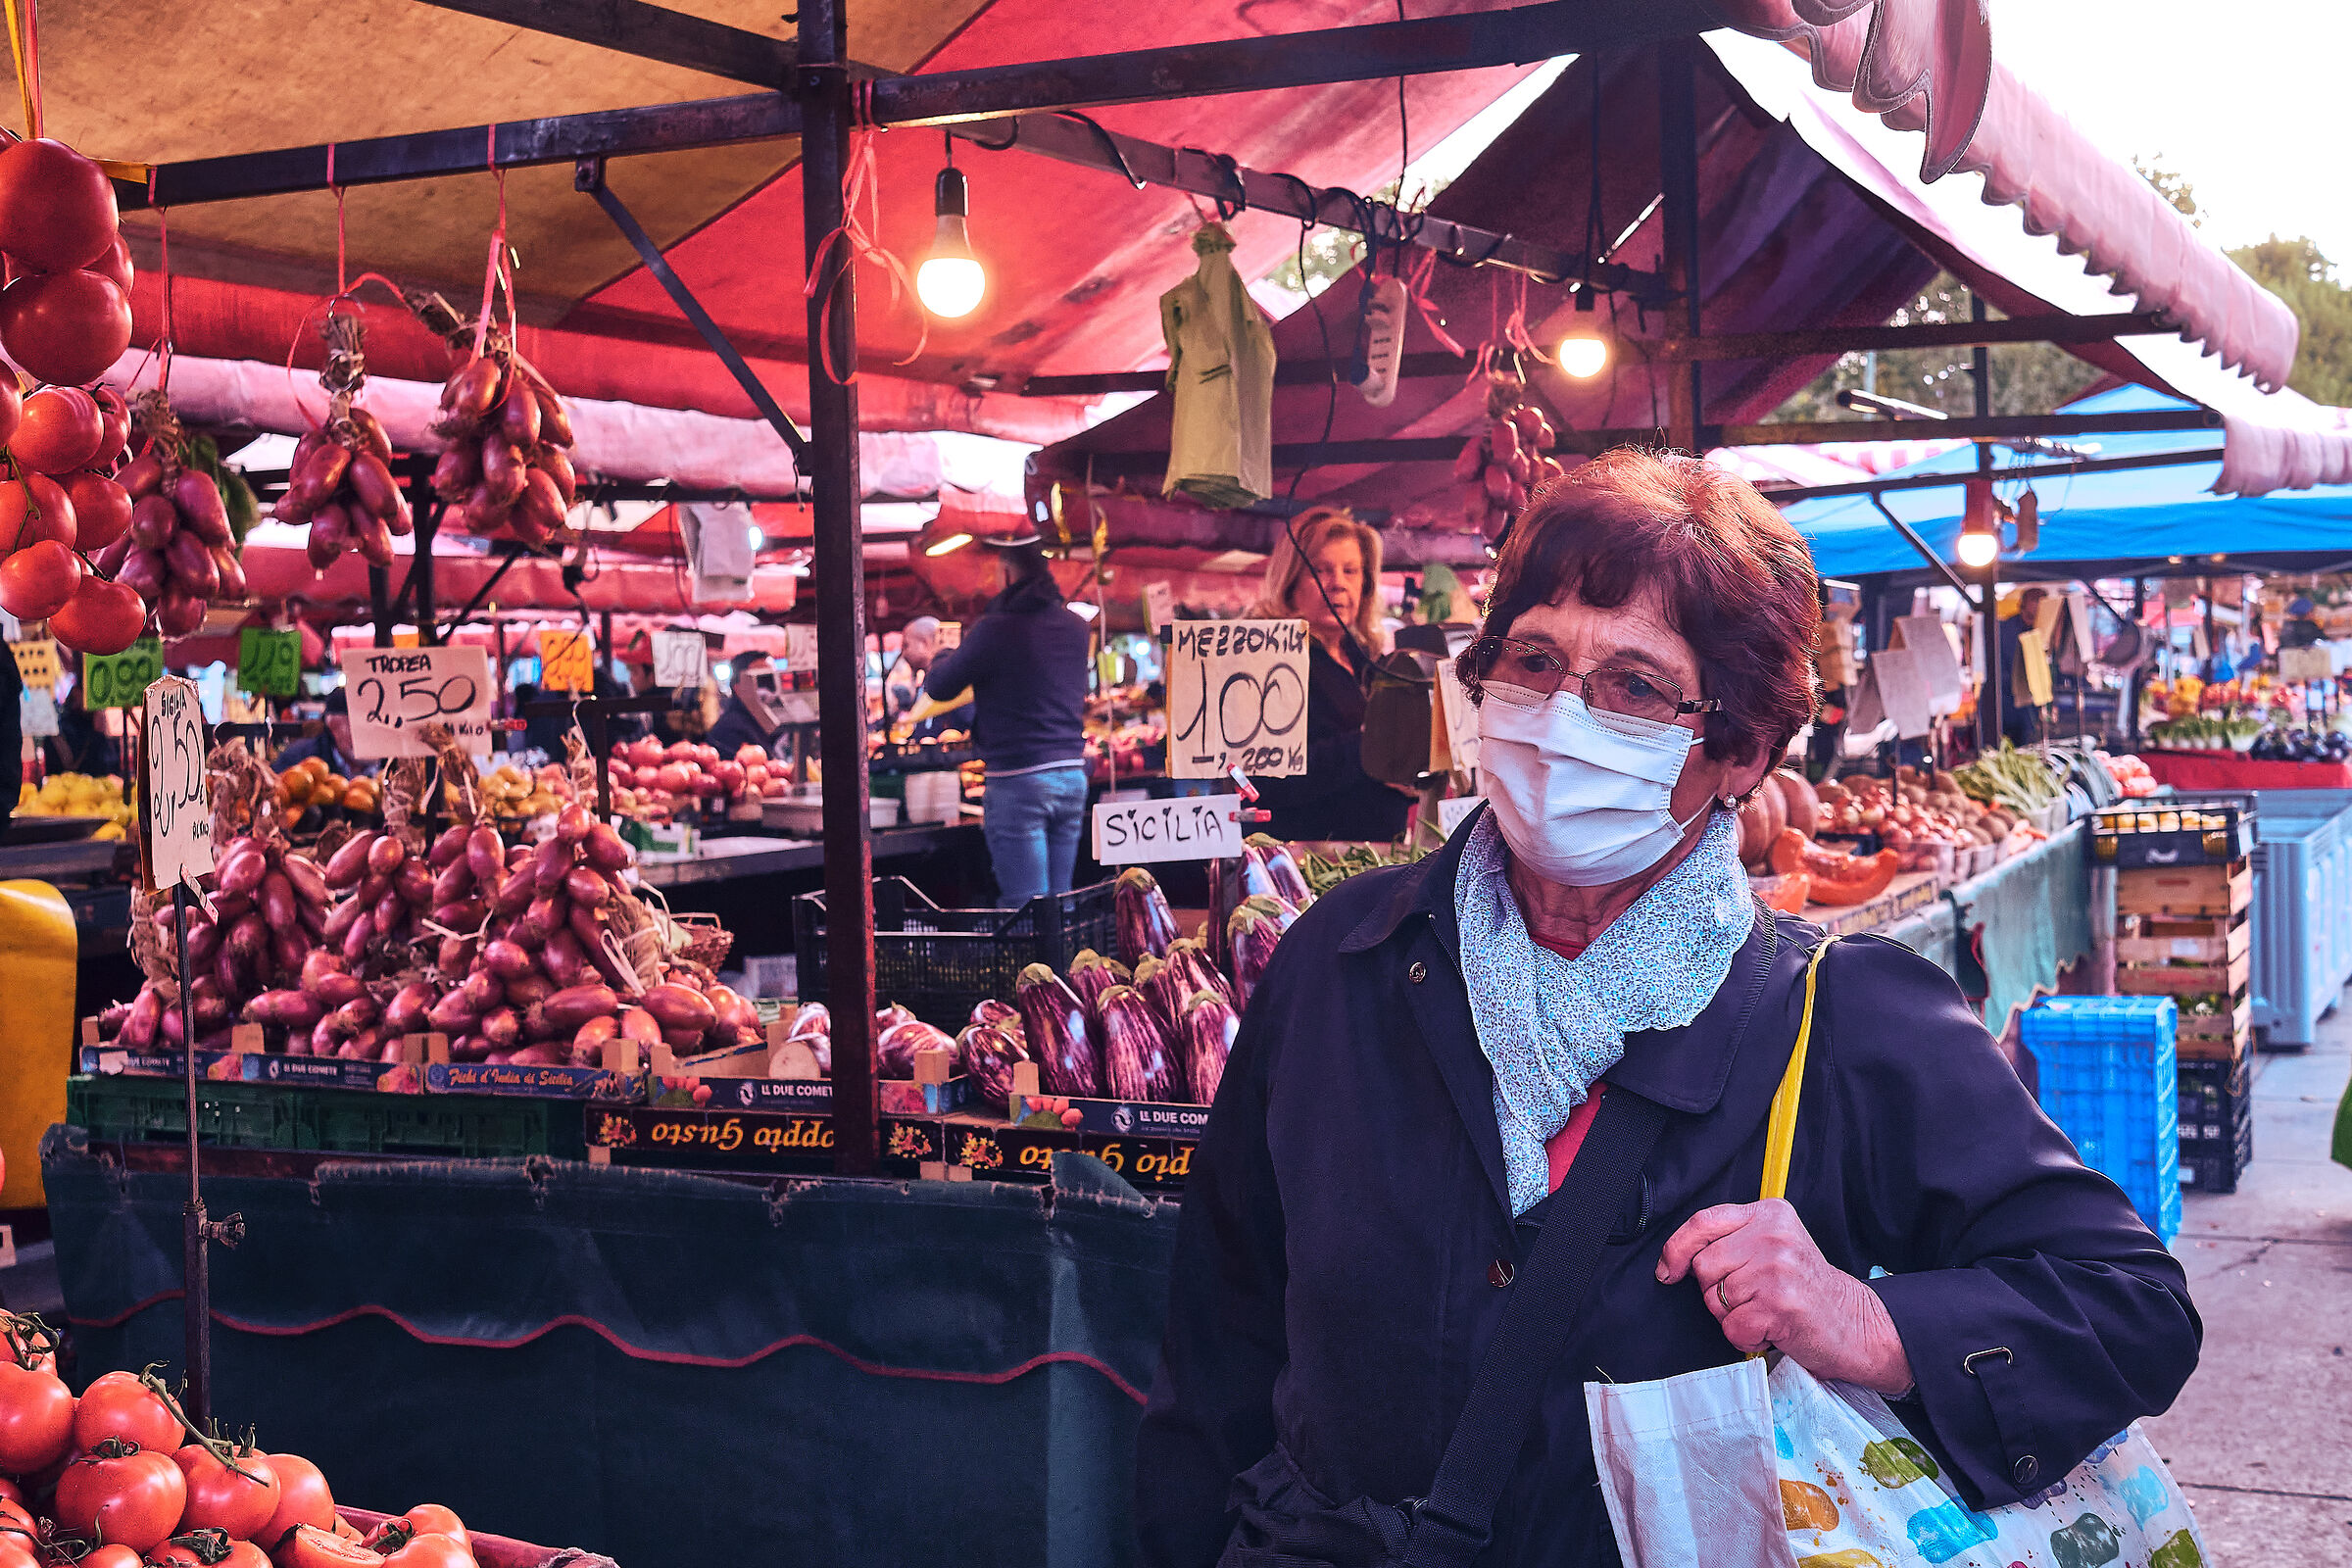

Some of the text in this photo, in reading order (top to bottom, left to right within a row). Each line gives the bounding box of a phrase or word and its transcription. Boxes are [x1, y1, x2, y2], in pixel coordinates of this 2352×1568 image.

[366, 654, 432, 673] TROPEA
[772, 1084, 795, 1097] DUE
[796, 1085, 833, 1098] COMET
[1152, 1110, 1178, 1124] DUE
[1179, 1112, 1209, 1126] COM
[651, 1117, 834, 1153] oppio Gusto
